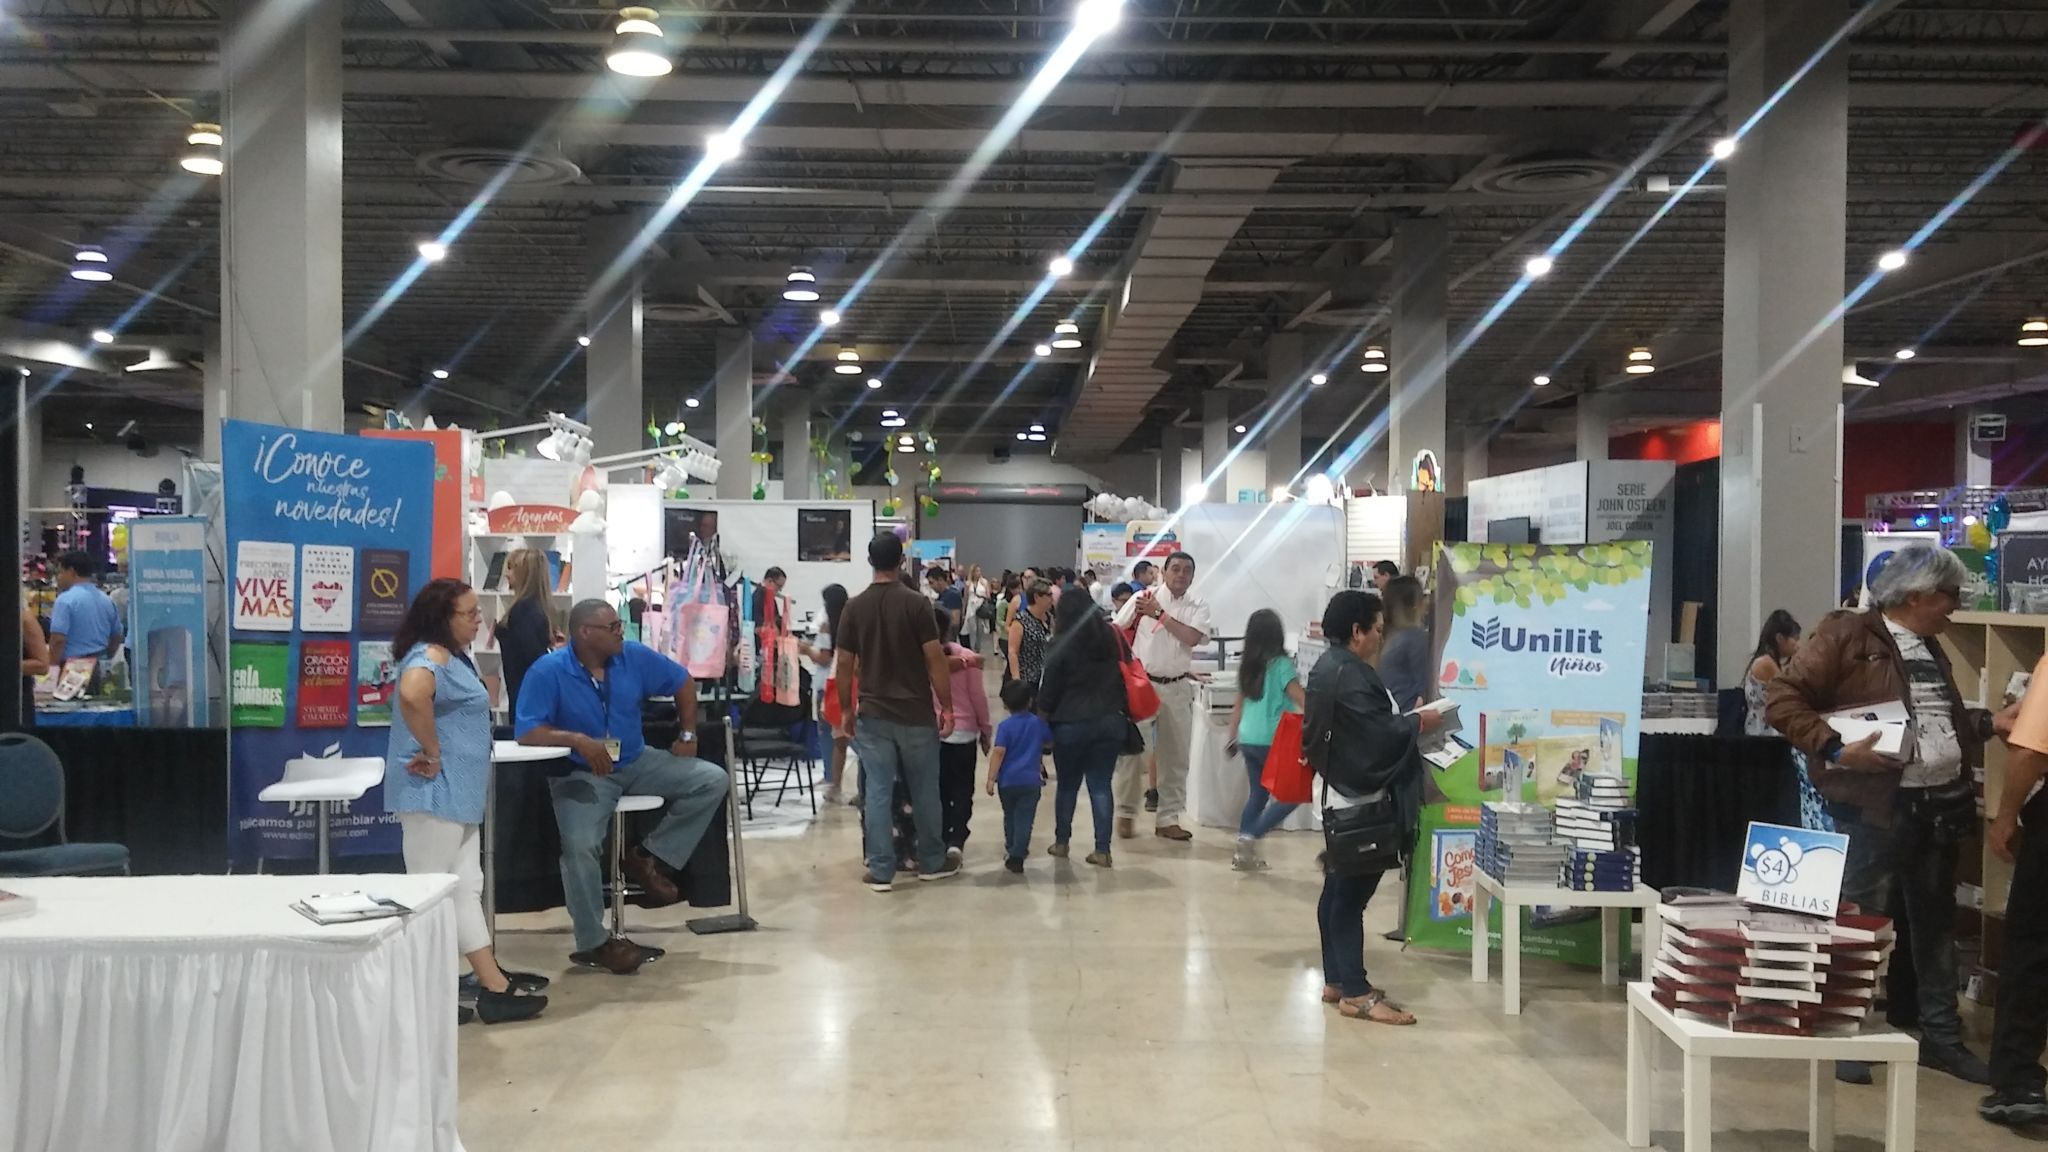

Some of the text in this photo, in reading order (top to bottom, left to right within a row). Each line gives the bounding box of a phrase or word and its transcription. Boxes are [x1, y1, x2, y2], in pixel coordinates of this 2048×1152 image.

[1617, 483, 1646, 496] SERIE
[275, 497, 402, 533] novedades!
[1597, 498, 1624, 512] JOHN
[1627, 499, 1666, 513] OSTEEN
[236, 577, 287, 598] VIVE
[1501, 627, 1603, 654] Unilit
[1550, 656, 1604, 676] Niños
[1760, 856, 1783, 876] $4
[1761, 889, 1831, 912] BIBLIAS
